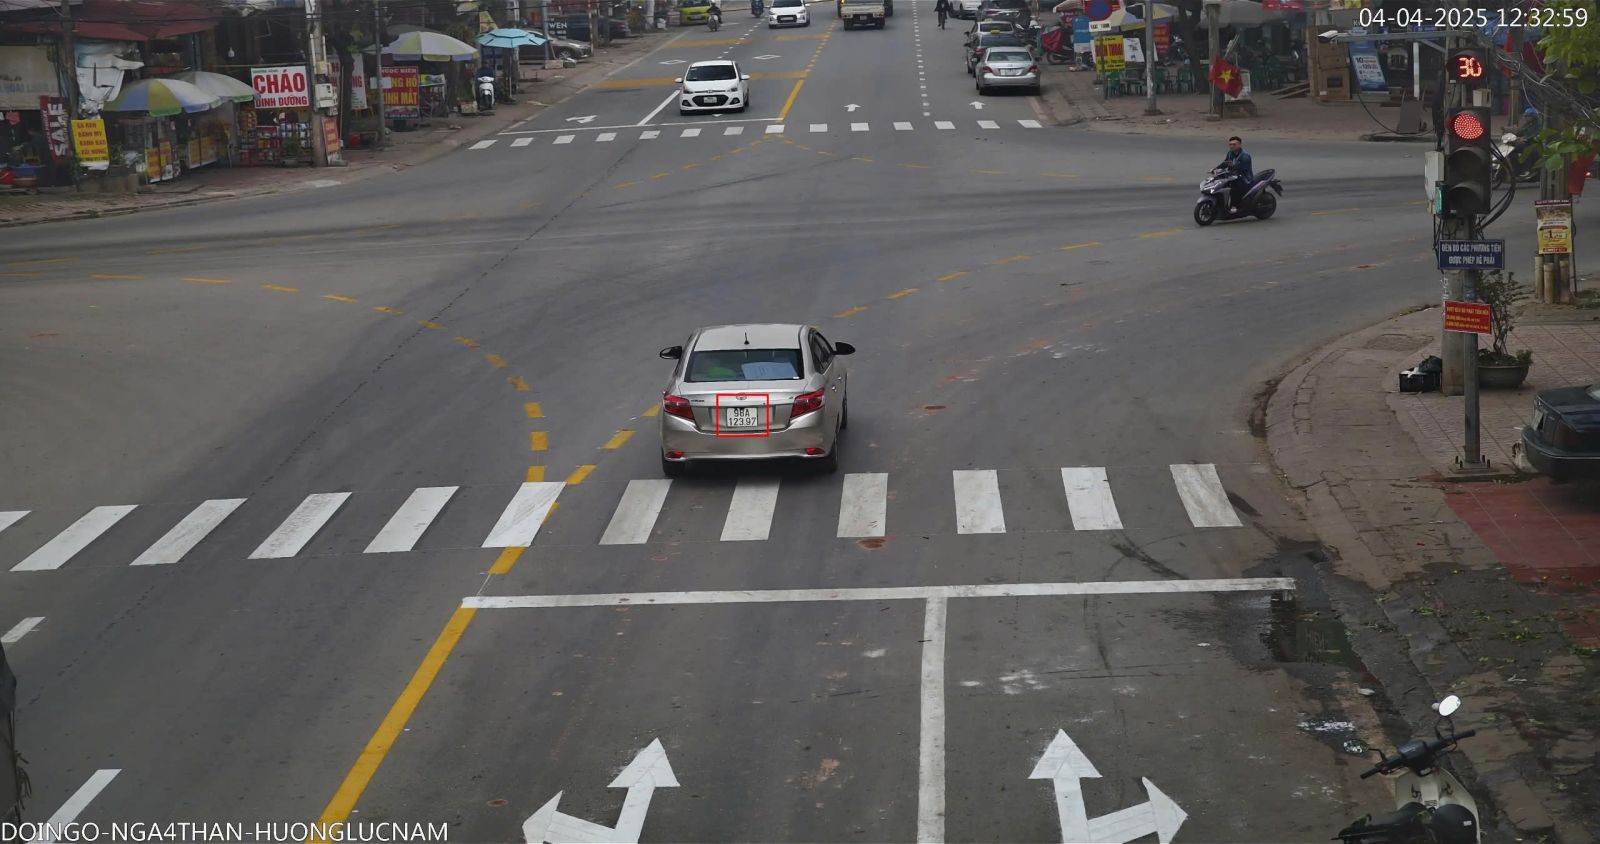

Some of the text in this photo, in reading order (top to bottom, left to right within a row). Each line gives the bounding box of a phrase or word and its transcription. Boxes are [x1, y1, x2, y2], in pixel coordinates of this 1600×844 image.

[1459, 57, 1482, 77] 30
[253, 69, 306, 94] CHÁO
[256, 97, 276, 107] DINH
[47, 103, 66, 156] SALE
[1460, 242, 1470, 252] CÁC
